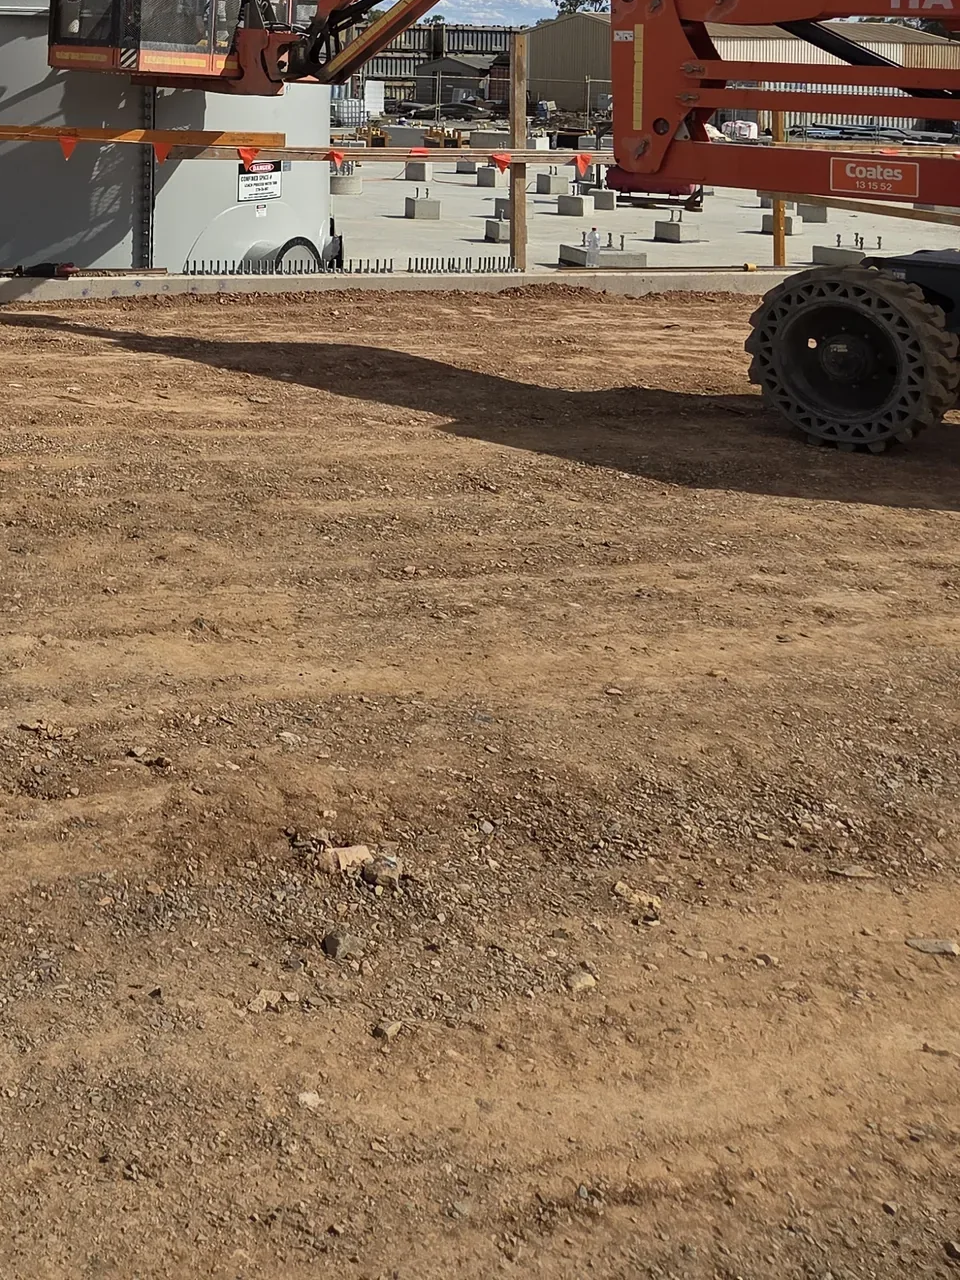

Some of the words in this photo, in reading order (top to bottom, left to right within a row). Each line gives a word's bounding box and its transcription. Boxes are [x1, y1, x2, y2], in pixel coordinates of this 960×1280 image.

[845, 163, 903, 181] Coates
[855, 180, 866, 189] 13
[868, 182, 878, 190] 15
[880, 183, 892, 191] 52
